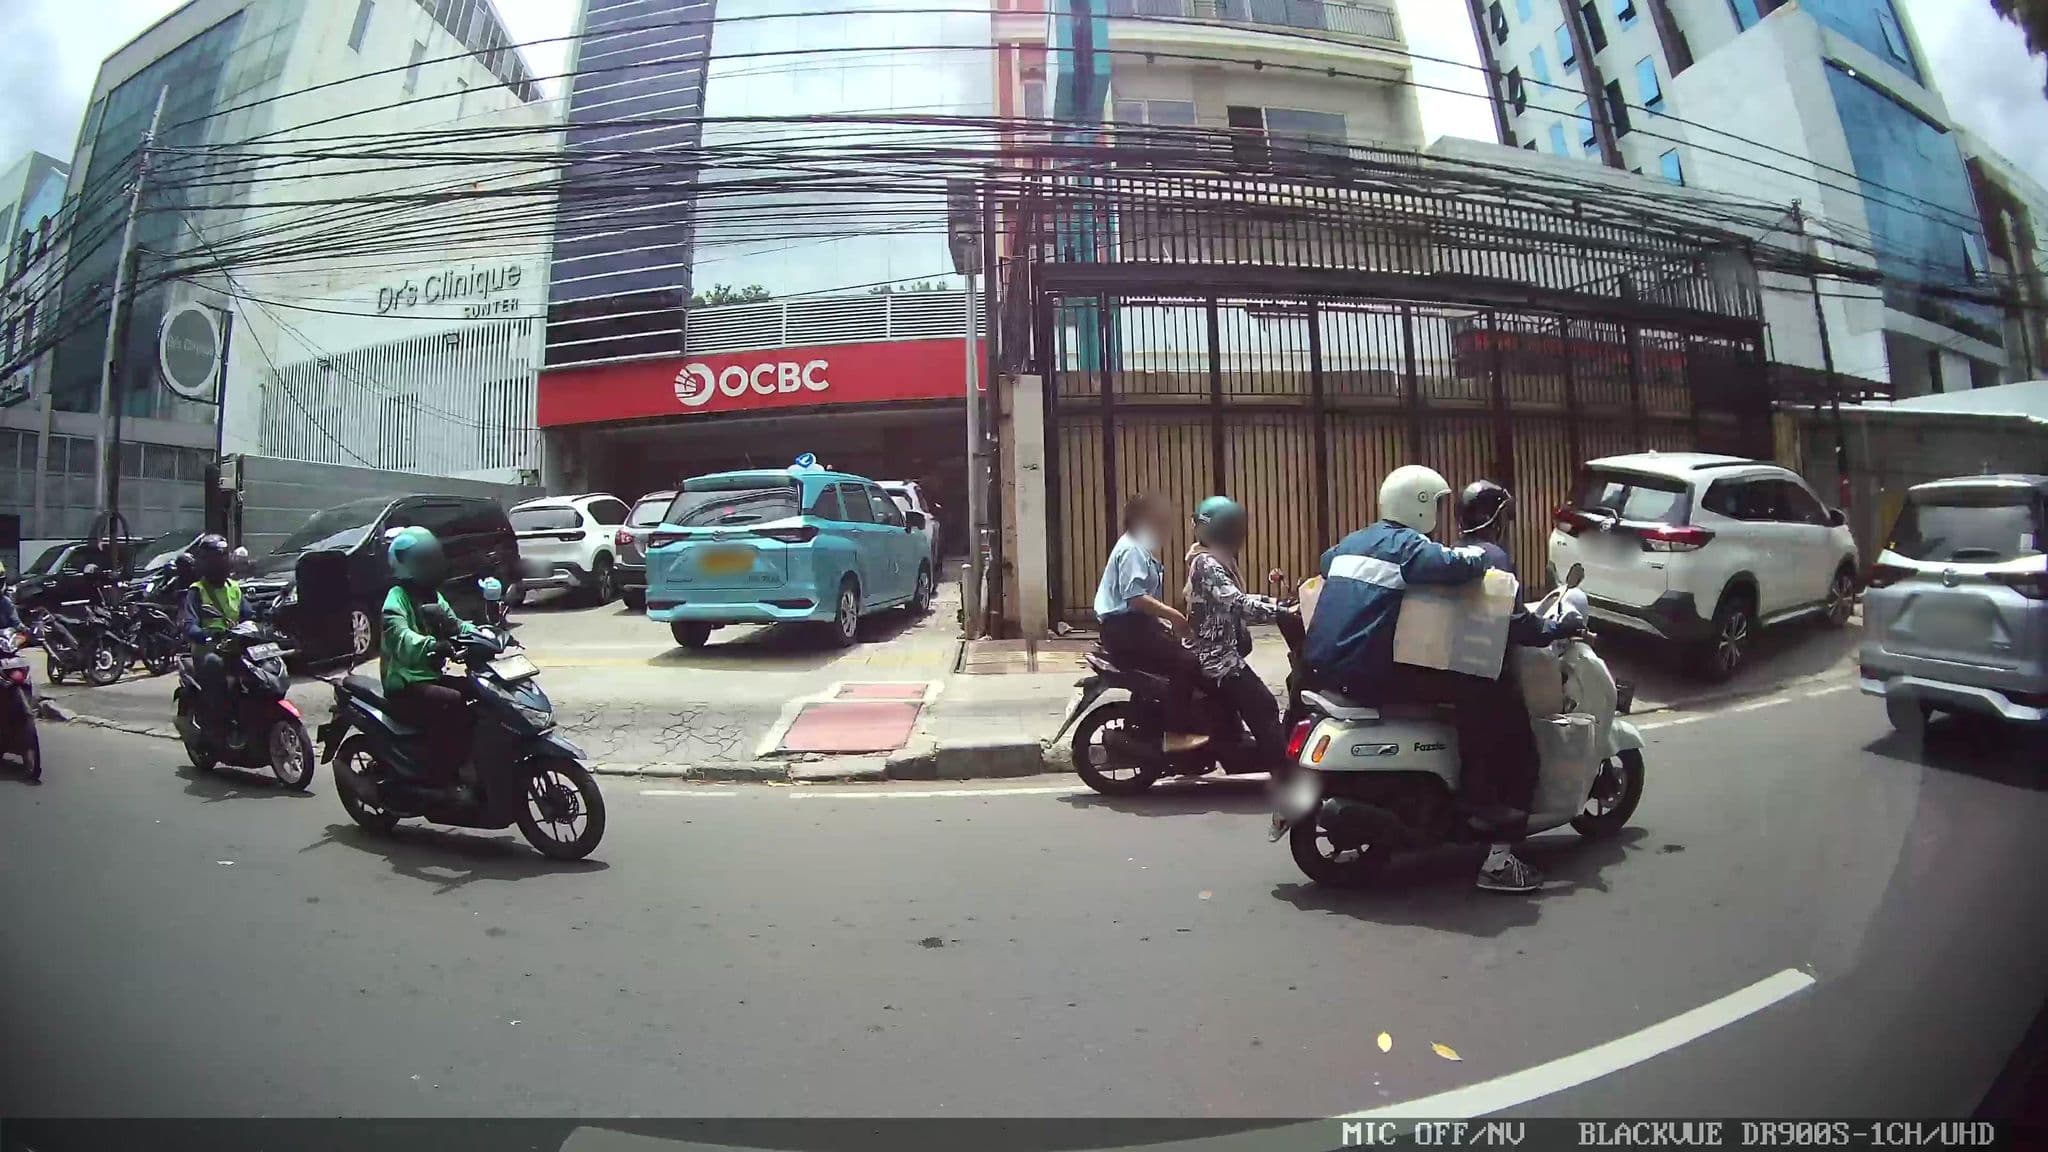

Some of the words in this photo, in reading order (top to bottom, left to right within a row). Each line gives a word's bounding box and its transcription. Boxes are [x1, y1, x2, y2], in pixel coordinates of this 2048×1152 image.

[376, 280, 418, 314] Dr's
[425, 264, 522, 303] Clinique
[718, 359, 830, 398] OCBC
